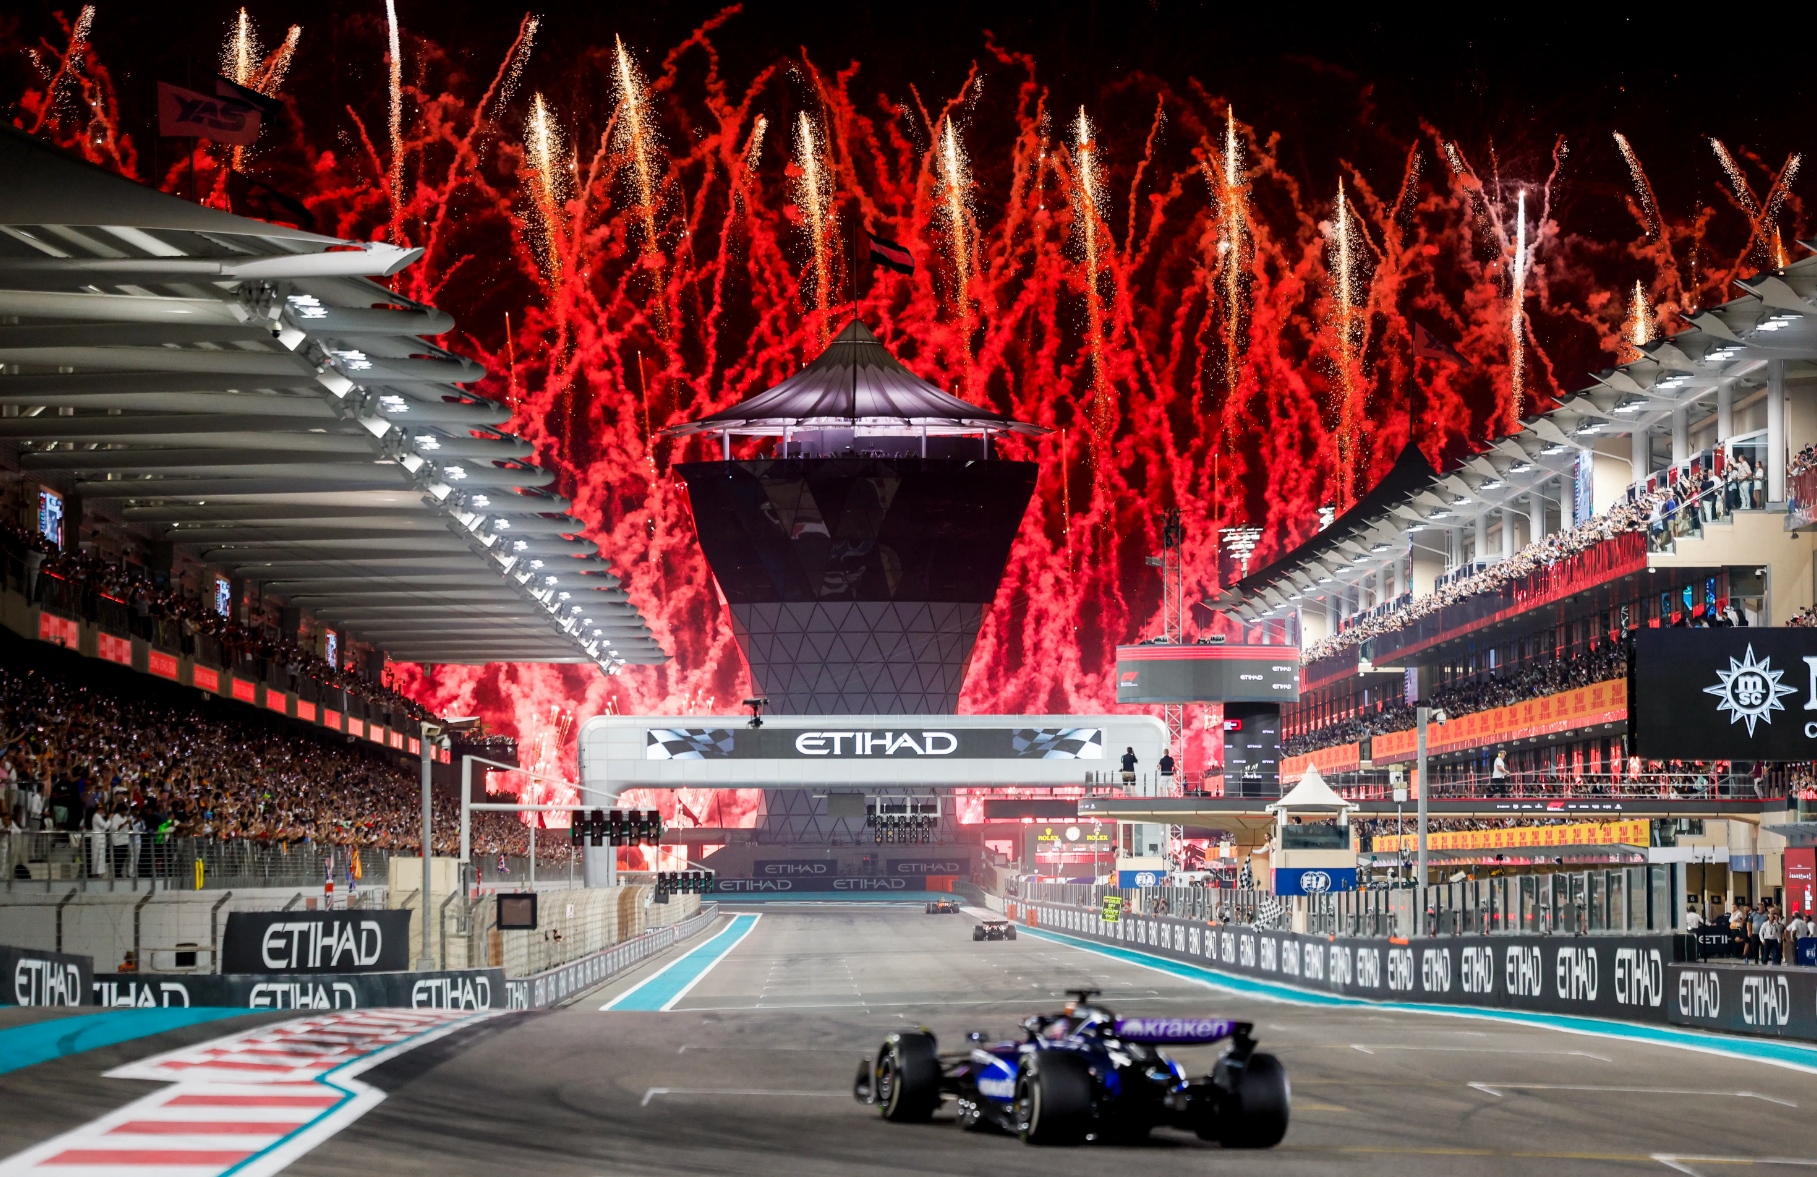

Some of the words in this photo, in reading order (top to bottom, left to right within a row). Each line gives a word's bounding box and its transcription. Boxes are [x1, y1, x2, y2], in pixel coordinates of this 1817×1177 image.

[795, 732, 958, 755] ETIHAD
[719, 879, 793, 892] ETIHAD
[764, 864, 827, 874] ETIHAD
[832, 877, 906, 890] ETIHAD
[897, 862, 959, 873] ETIHAD
[1136, 873, 1156, 885] FIA
[1302, 876, 1328, 889] FIA
[261, 920, 382, 969] ETIHAD
[14, 958, 81, 1006] ETIHAD
[1388, 948, 1414, 990] ETIHAD
[1421, 948, 1451, 992] ETIHAD
[1461, 946, 1493, 993] ETIHAD
[1506, 946, 1542, 997] ETIHAD
[1556, 947, 1598, 1000] ETIHAD
[1615, 948, 1663, 1007] ETIHAD
[411, 976, 491, 1010] ETIHAD
[506, 982, 529, 1011] TIHAD
[1678, 971, 1720, 1019] ETIHAD
[1742, 975, 1790, 1026] ETIHAD
[1144, 1018, 1229, 1037] kraken
